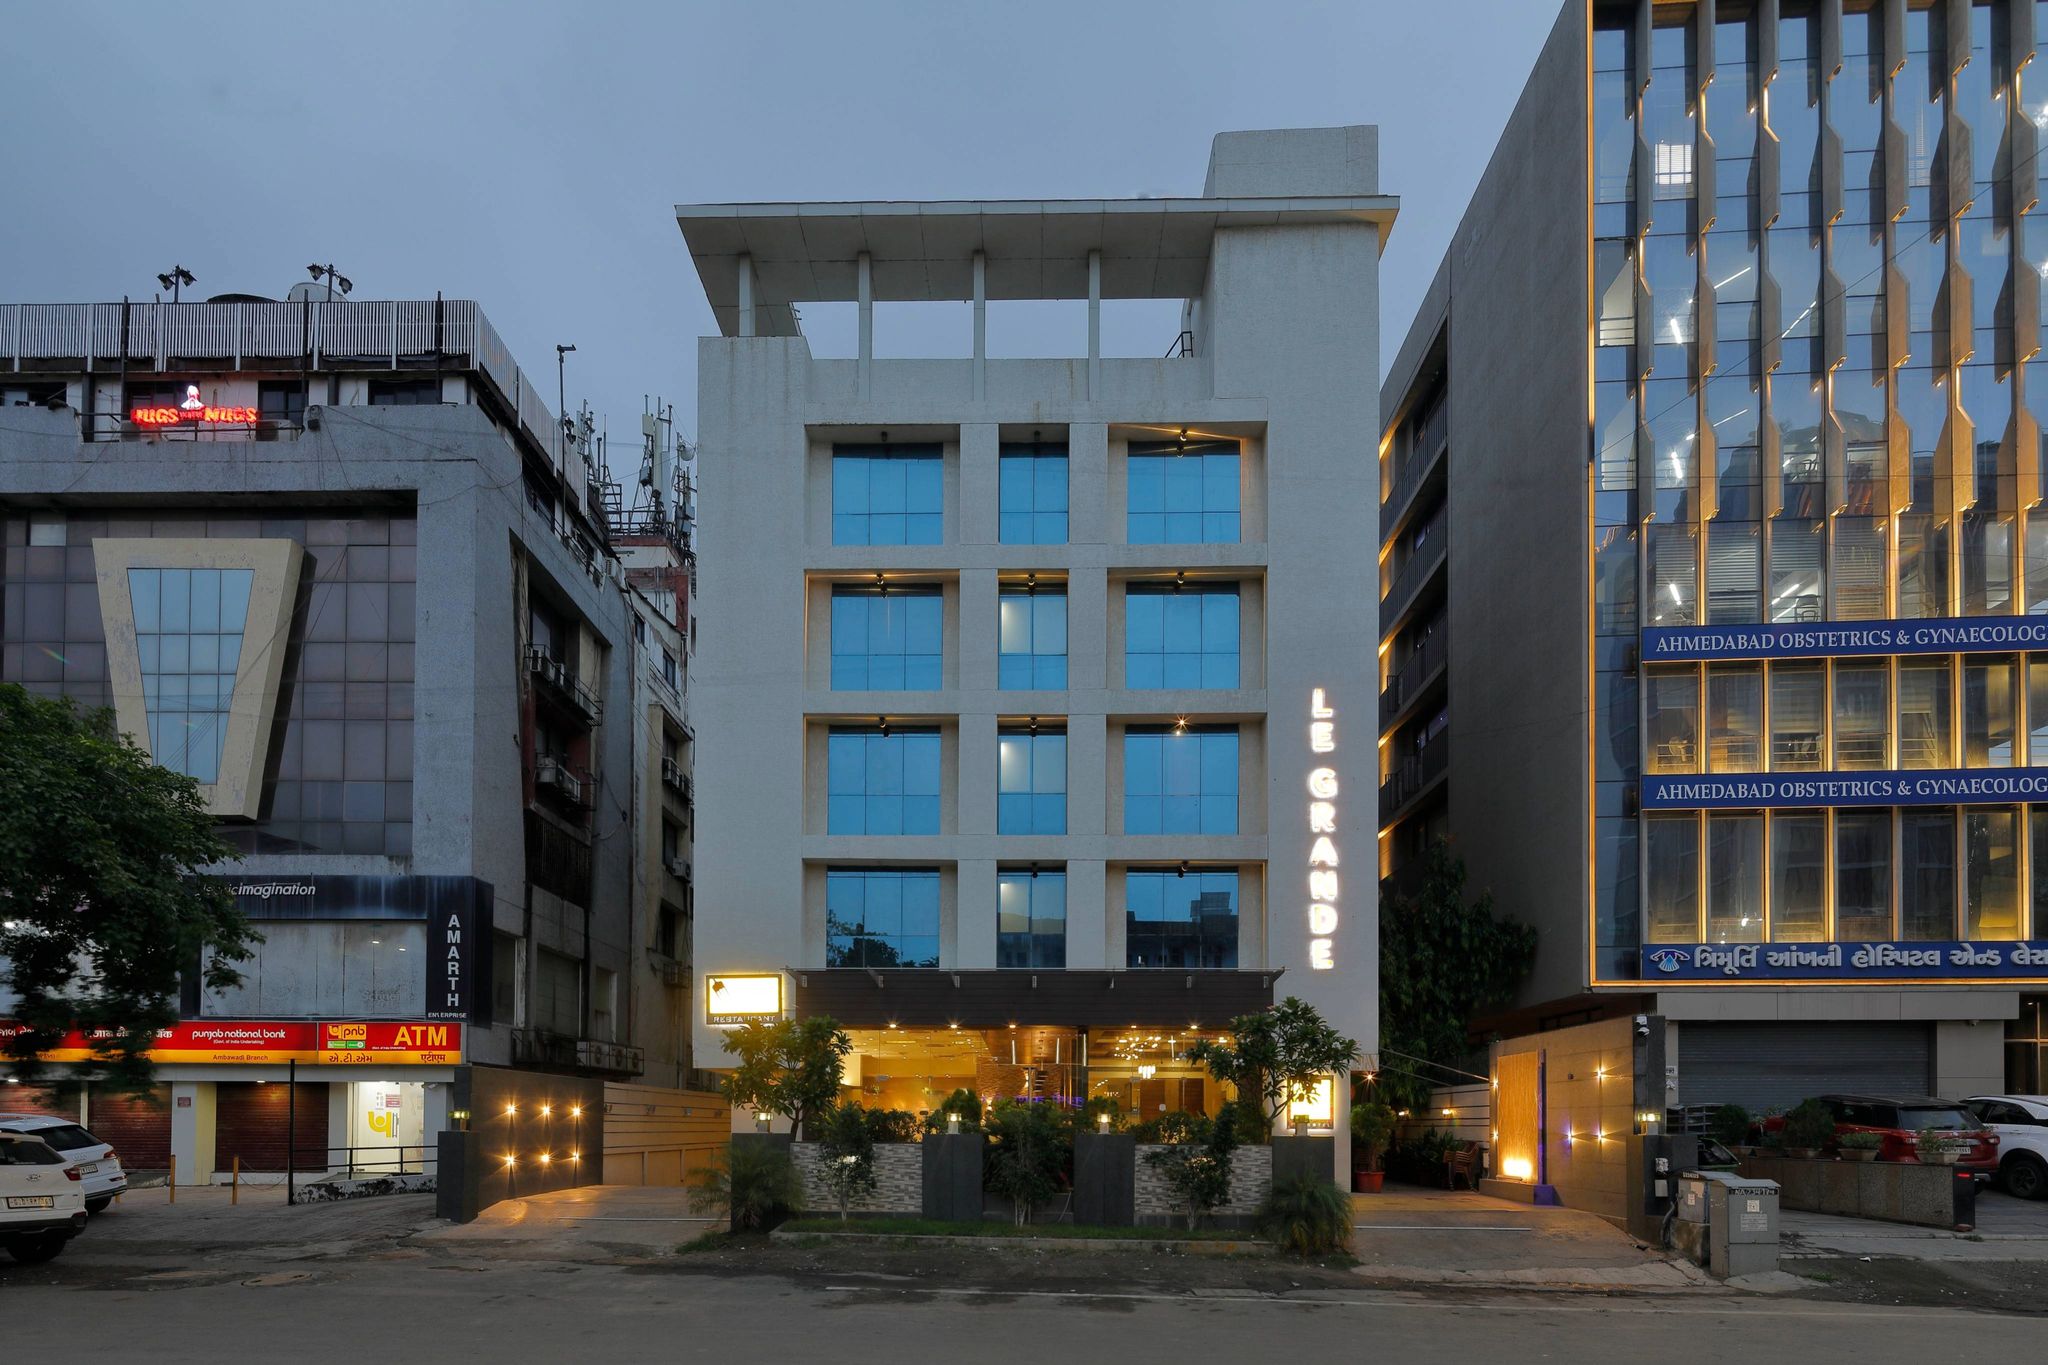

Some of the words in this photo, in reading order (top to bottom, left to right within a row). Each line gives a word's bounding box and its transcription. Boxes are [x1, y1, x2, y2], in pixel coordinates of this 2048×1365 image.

[1656, 634, 1775, 652] AHMEDABAD
[1779, 630, 1891, 648] OBSTETRICS
[1896, 630, 1911, 645] &
[1914, 625, 2048, 645] GYNAECOLOG
[1310, 688, 1335, 753] LE
[1656, 782, 1775, 800] AHMEDABAD
[1779, 780, 1892, 797] OBSTETRICS
[1897, 780, 1911, 796] &
[1308, 767, 1339, 970] GRANDE
[447, 914, 461, 1007] AMARTH
[192, 1029, 224, 1040] punjab
[224, 1029, 262, 1039] national
[263, 1029, 286, 1039] bank
[343, 1027, 366, 1039] pnb
[393, 1025, 447, 1047] ATM
